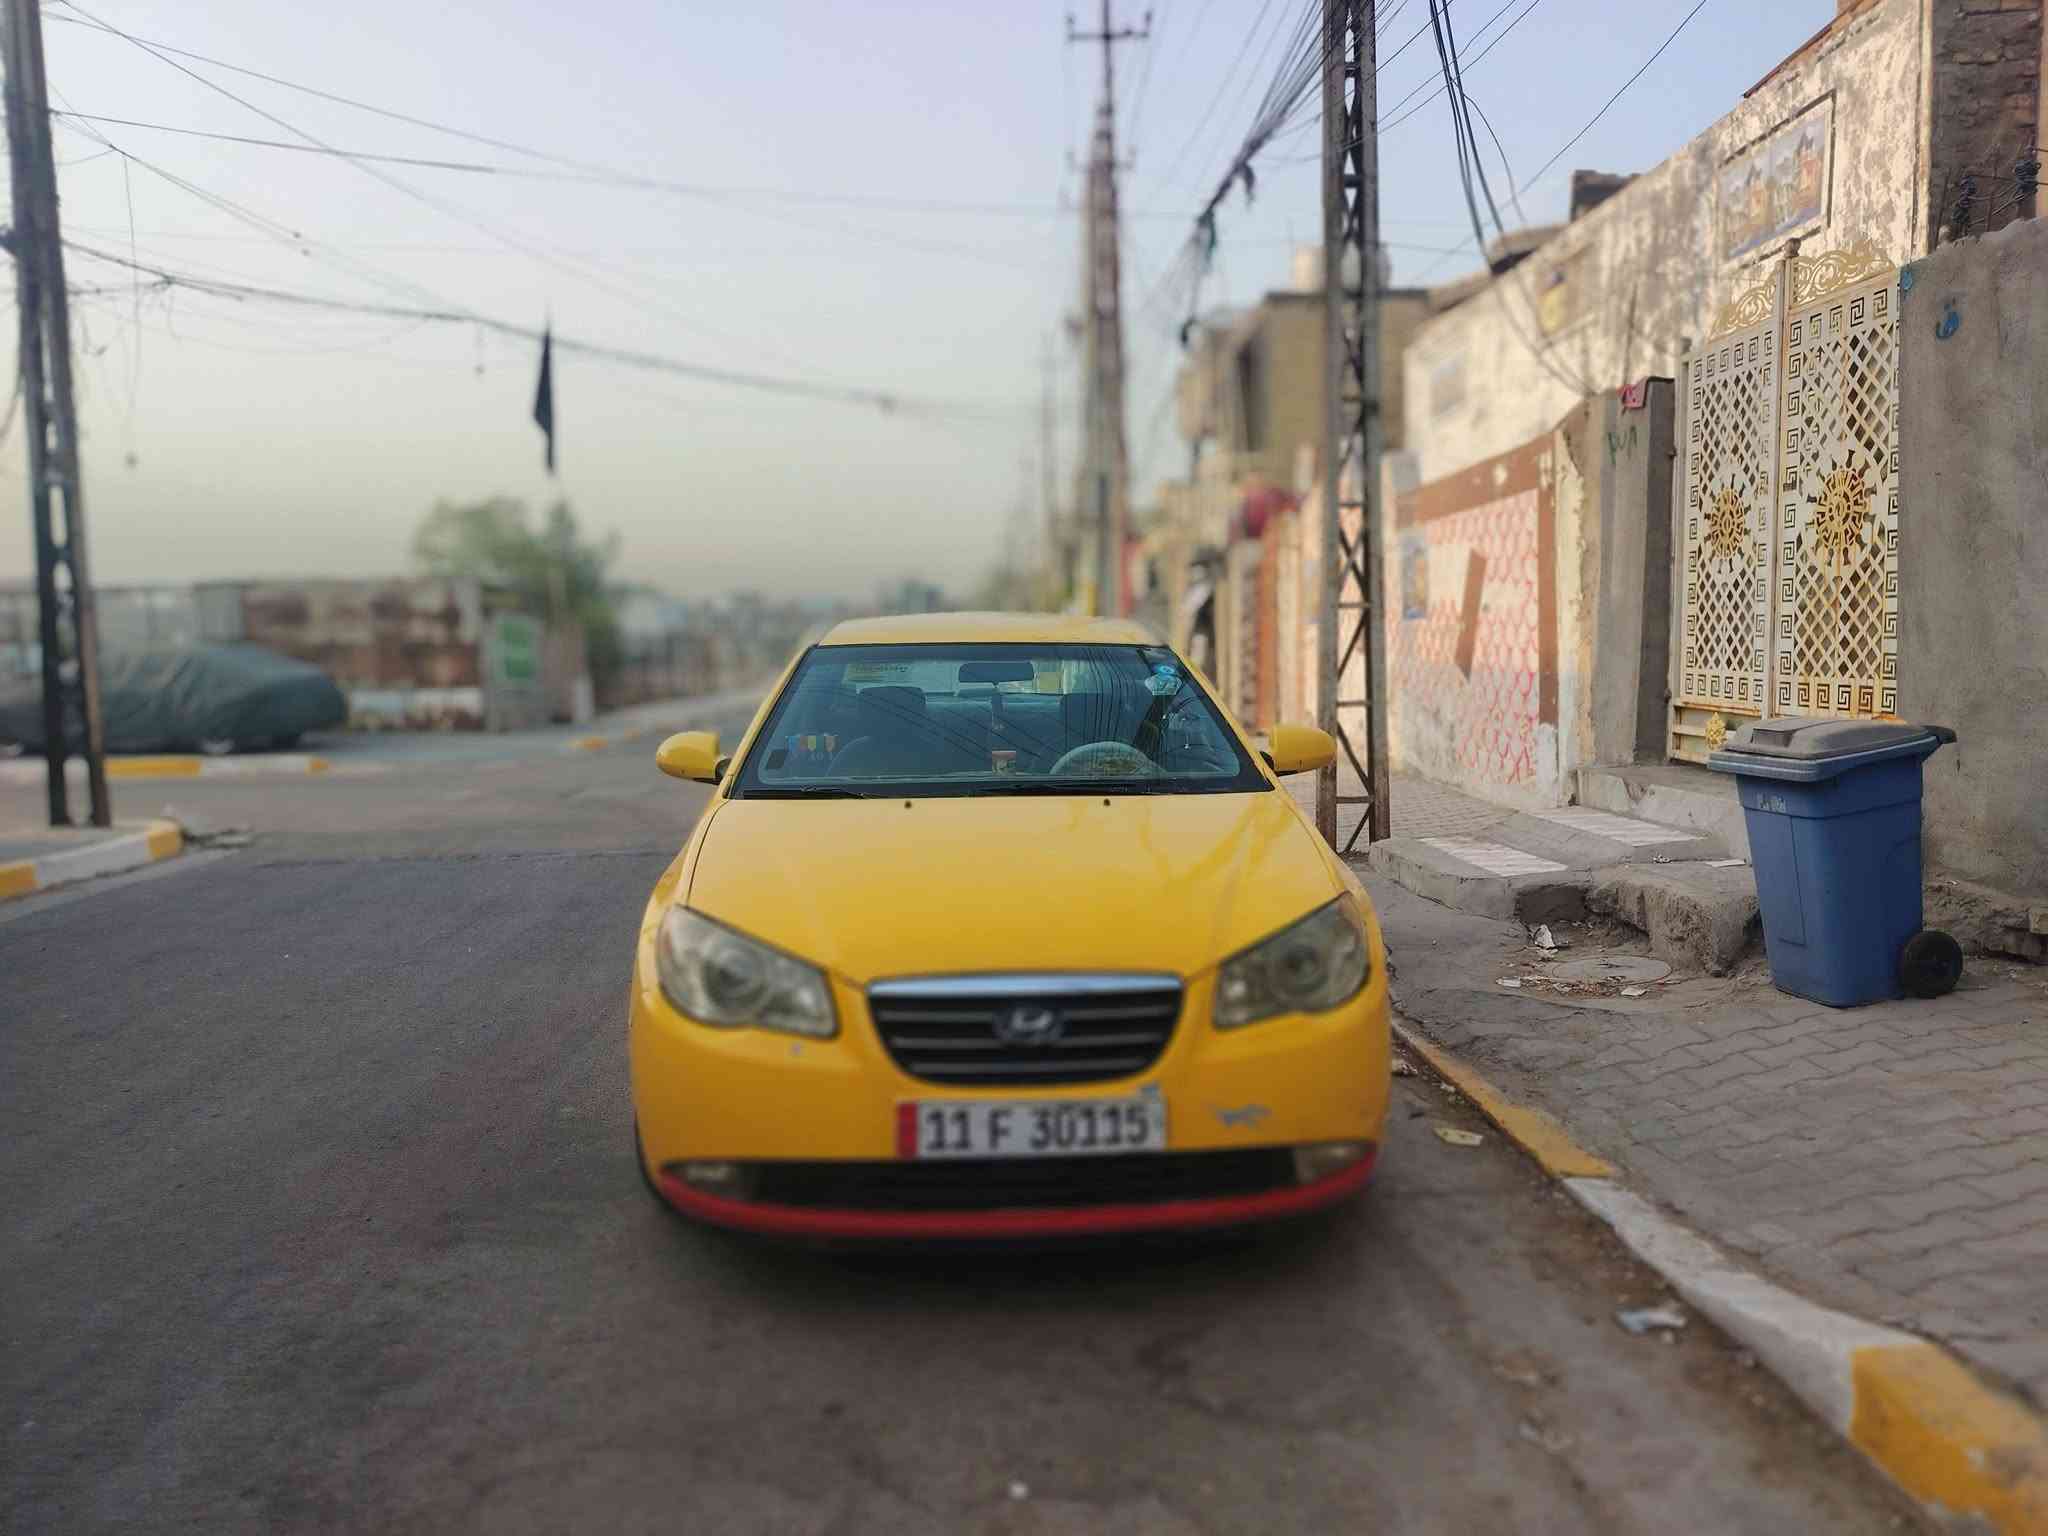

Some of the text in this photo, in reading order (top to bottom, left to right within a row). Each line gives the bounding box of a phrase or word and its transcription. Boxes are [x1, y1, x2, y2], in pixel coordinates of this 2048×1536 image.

[926, 1103, 1149, 1150] 11 F 30115
